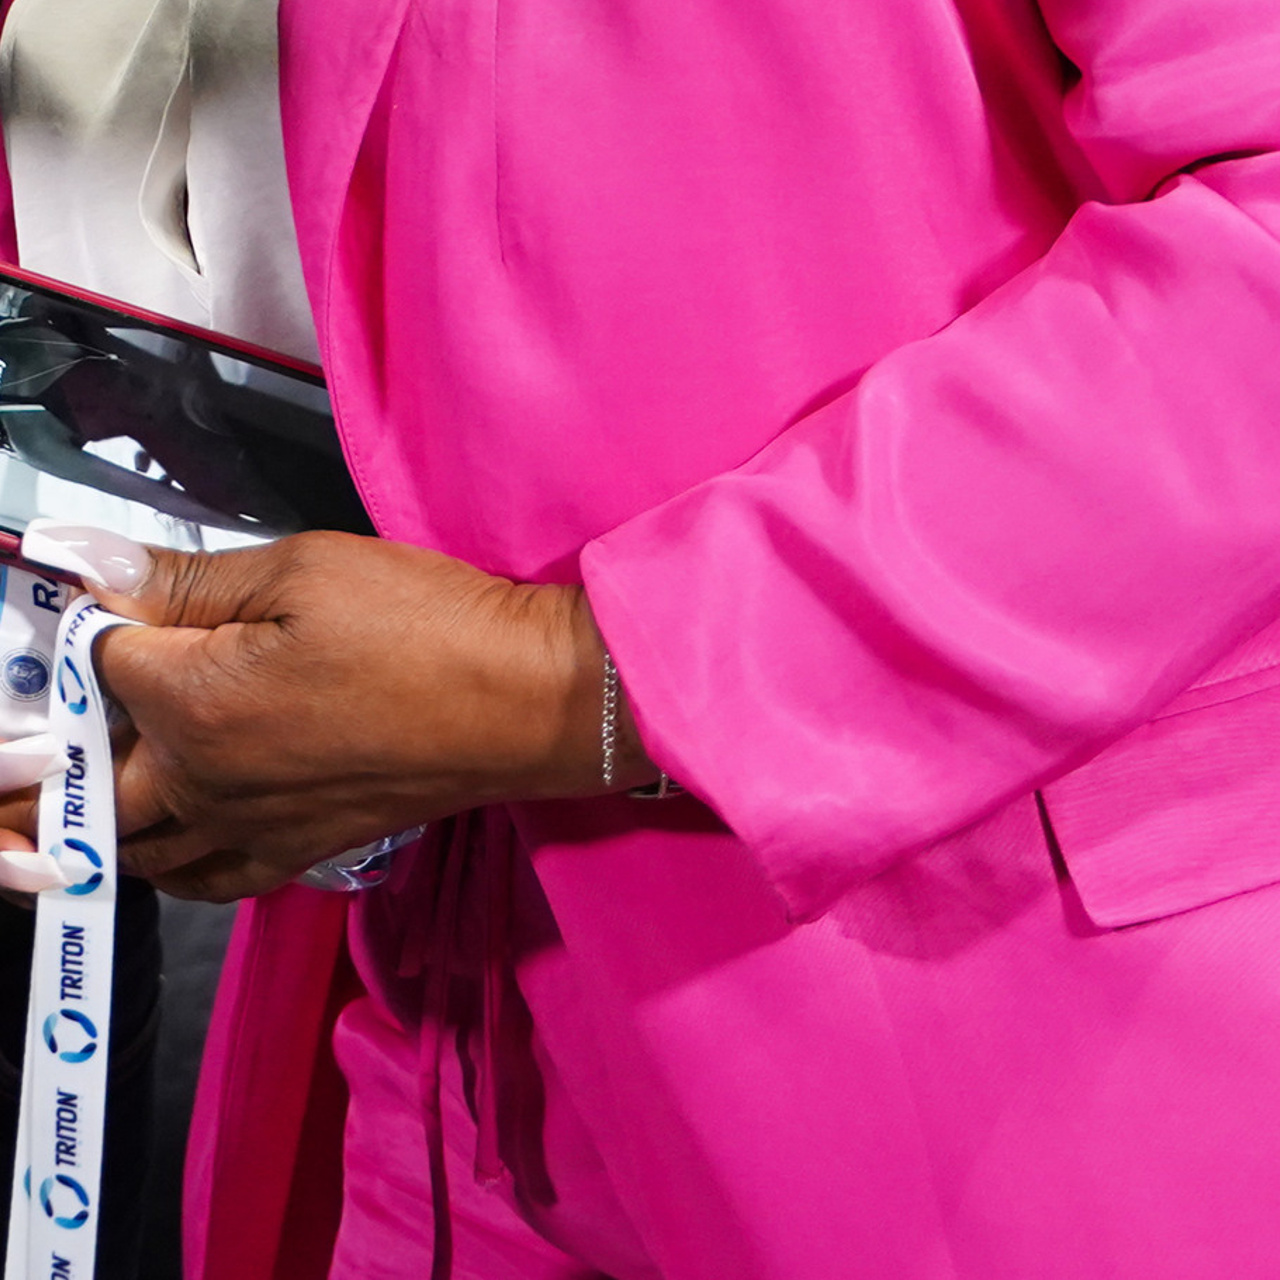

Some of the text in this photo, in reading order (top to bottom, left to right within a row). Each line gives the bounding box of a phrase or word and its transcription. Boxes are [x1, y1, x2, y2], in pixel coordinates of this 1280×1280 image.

[31, 578, 61, 614] R
[64, 602, 112, 648] TRIT
[64, 743, 85, 829] TRITON
[60, 924, 85, 1001] TRITON
[55, 1090, 78, 1167] TRITON
